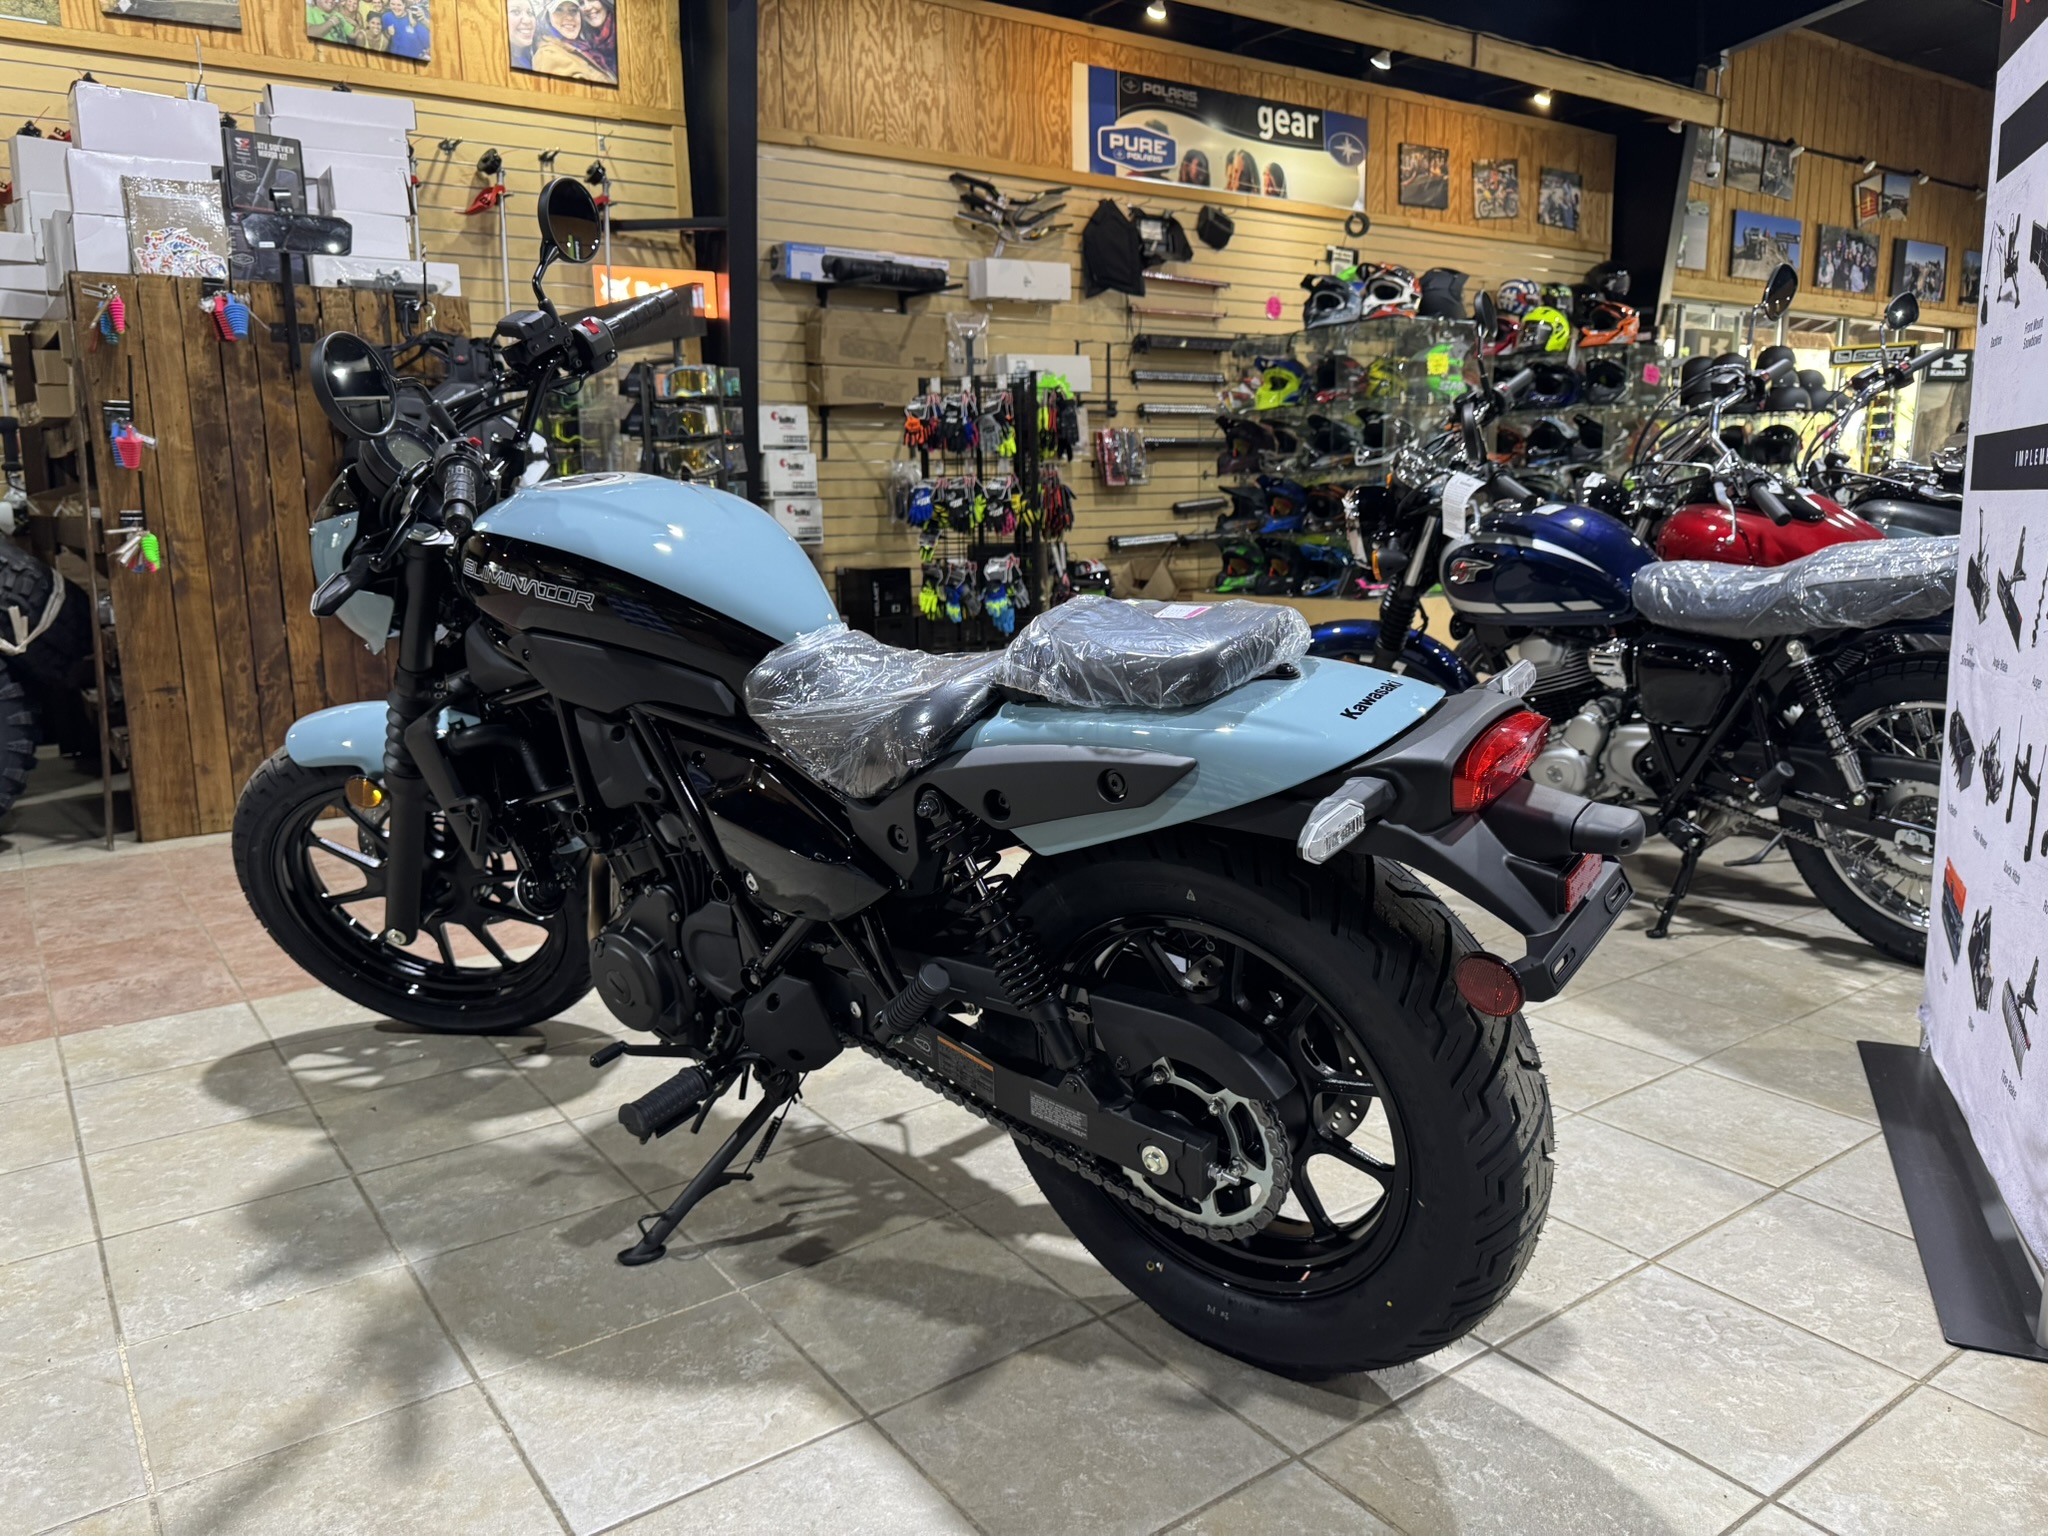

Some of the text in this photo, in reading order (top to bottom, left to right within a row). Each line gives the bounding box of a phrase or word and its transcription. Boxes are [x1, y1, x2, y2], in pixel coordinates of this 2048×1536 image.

[1142, 82, 1198, 102] POLARIS
[1257, 105, 1320, 140] gear
[1109, 133, 1168, 156] PURE
[1126, 151, 1163, 163] POLARIS
[1929, 369, 1966, 377] Kawasaki
[462, 557, 596, 611] ELIMINATOR
[1340, 680, 1404, 720] Kawasaki
